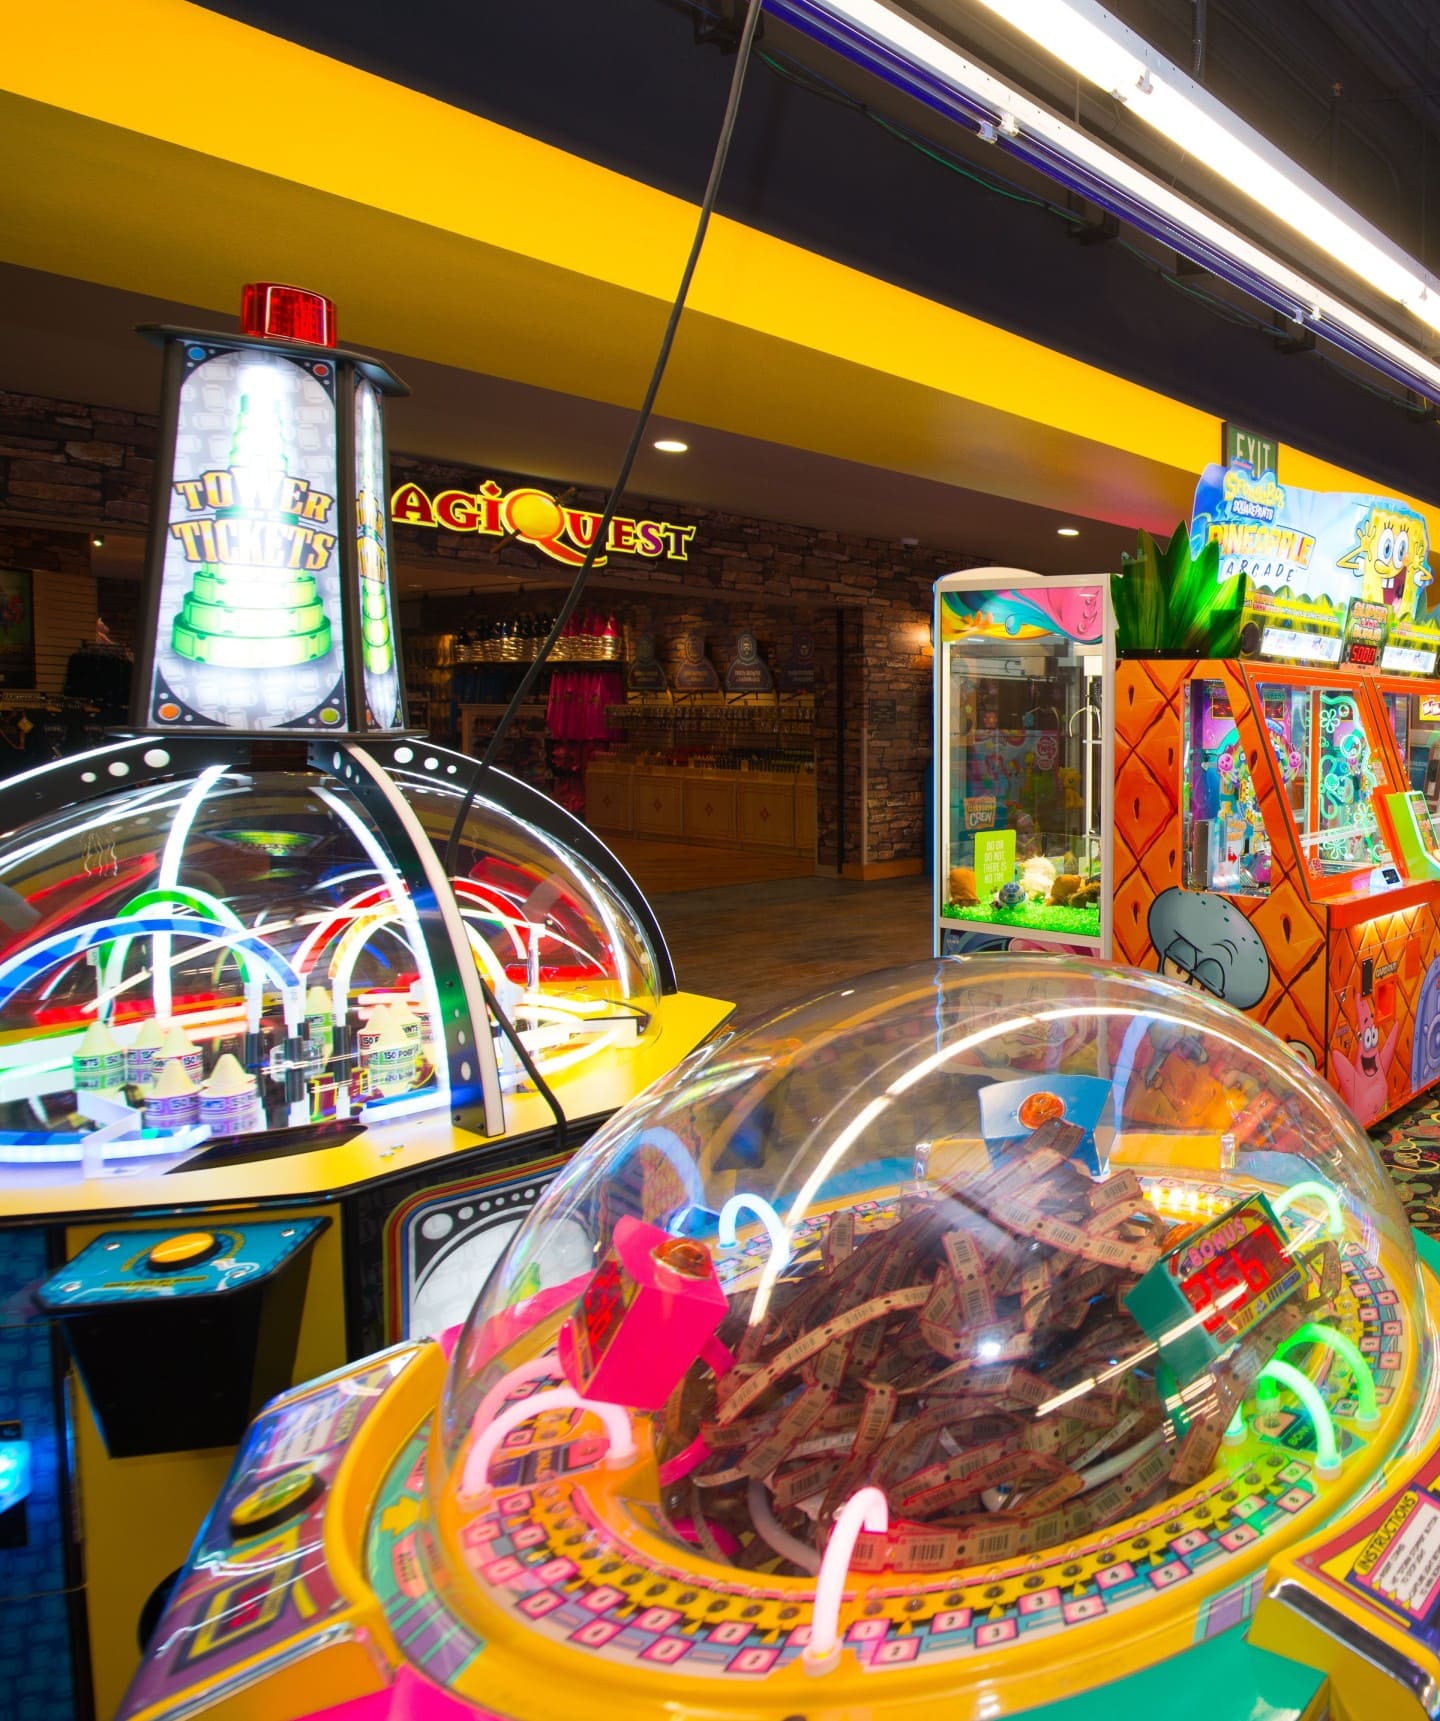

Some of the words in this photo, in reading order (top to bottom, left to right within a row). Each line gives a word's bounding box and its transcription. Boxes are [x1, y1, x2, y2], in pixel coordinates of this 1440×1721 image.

[1236, 433, 1271, 481] EXIT
[173, 466, 335, 524] TOWER
[169, 517, 337, 571] TICKETS
[391, 480, 697, 568] AGIQUEST
[1207, 523, 1315, 567] PINEAPPLE
[1226, 559, 1295, 583] ARCADE
[1184, 1214, 1249, 1268] BONUS
[1355, 1493, 1417, 1572] INSTRUCTIONS
